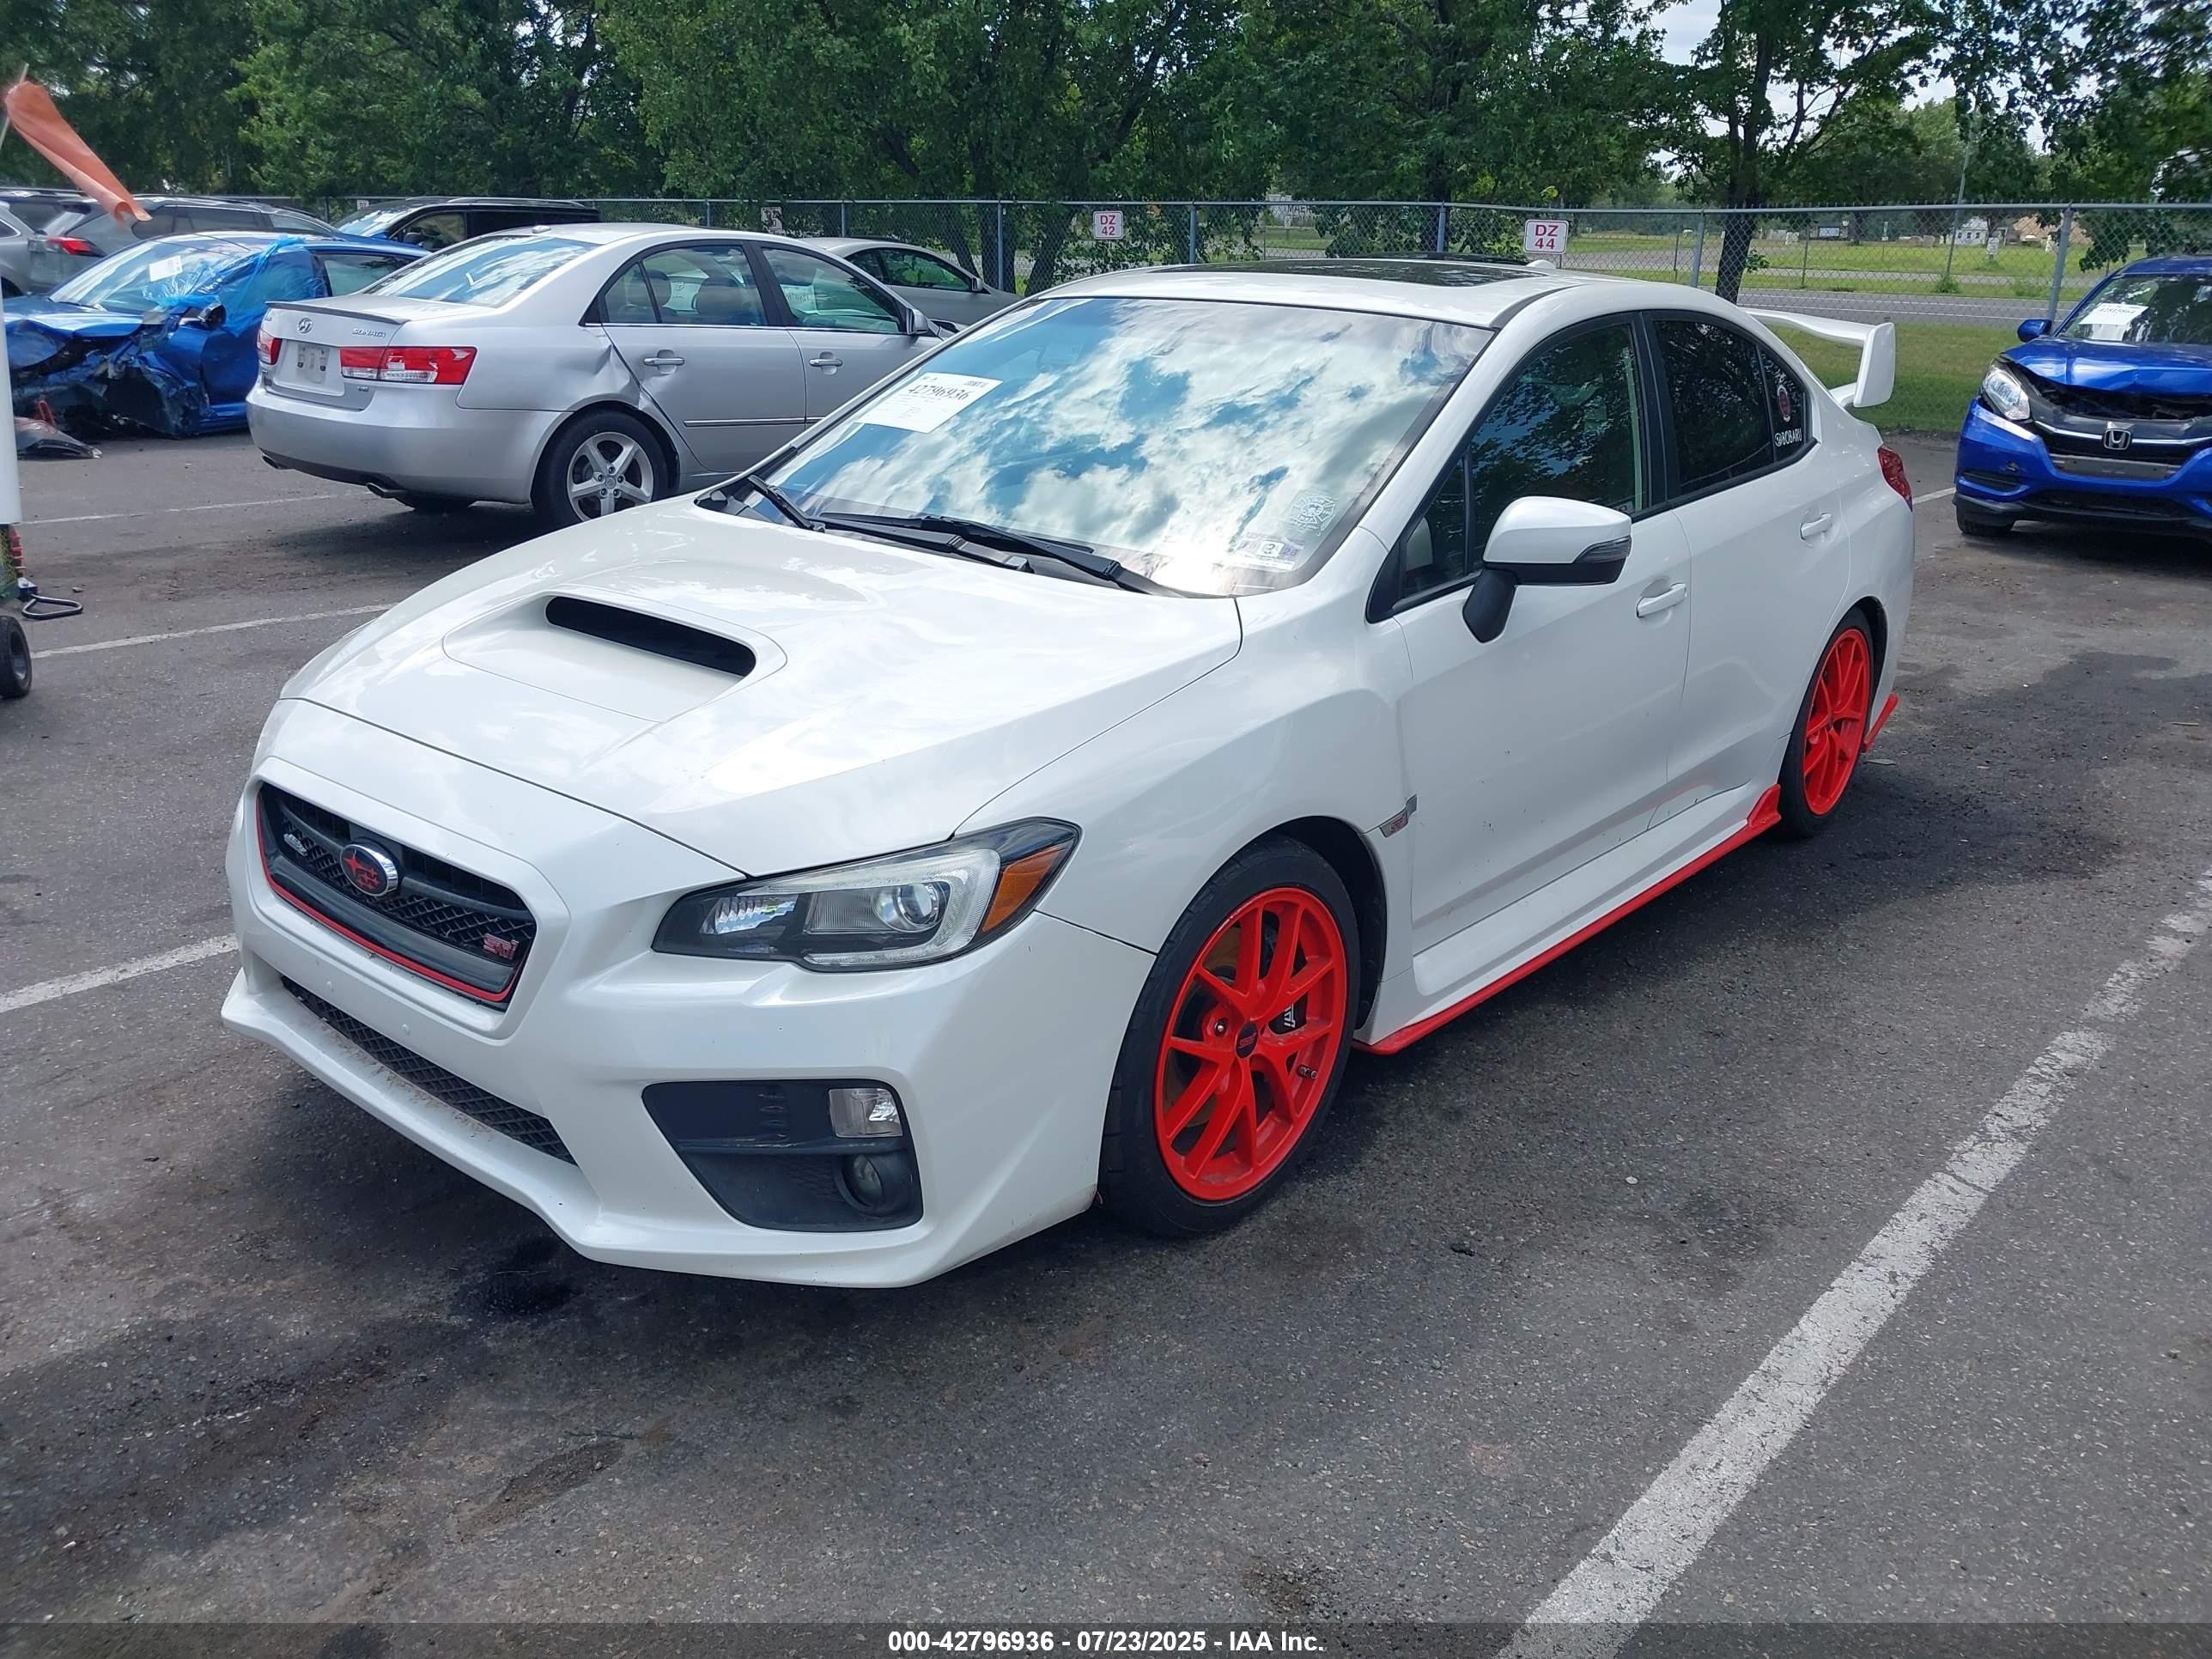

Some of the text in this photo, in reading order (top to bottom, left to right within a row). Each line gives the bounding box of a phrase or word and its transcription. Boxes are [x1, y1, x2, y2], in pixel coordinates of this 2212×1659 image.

[1100, 215, 1116, 225] DZ
[1101, 226, 1115, 235] 42
[1534, 224, 1559, 237] DZ
[1534, 238, 1555, 249] 44
